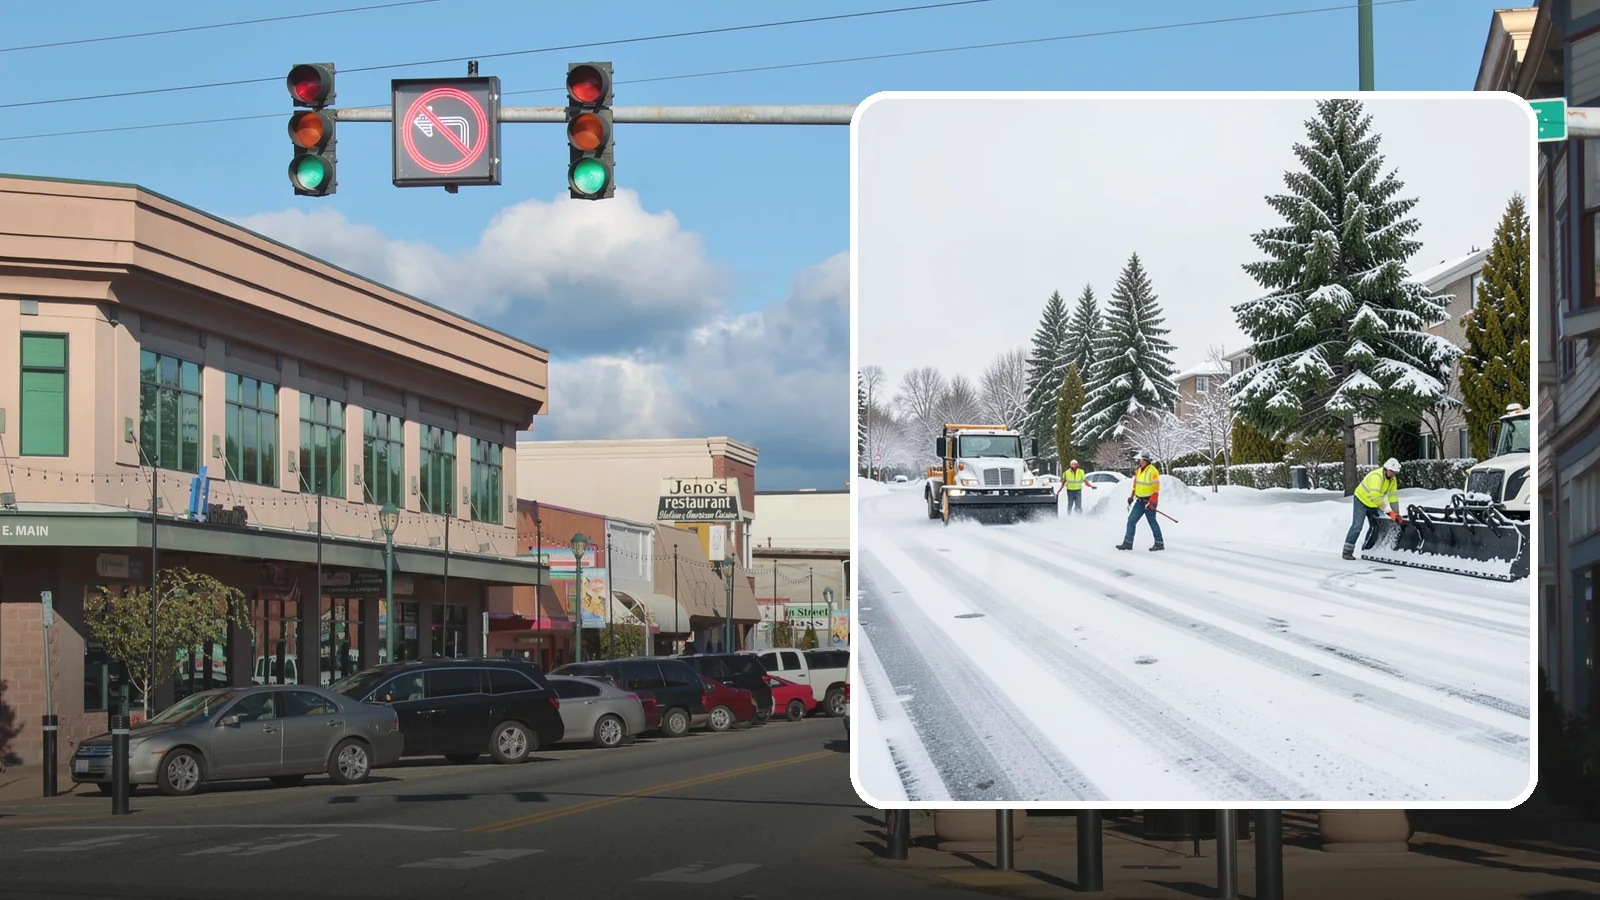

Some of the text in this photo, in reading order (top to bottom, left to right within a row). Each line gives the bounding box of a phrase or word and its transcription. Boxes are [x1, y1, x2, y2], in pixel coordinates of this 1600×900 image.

[670, 480, 727, 494] Jeno's
[665, 496, 731, 509] restaurant
[659, 510, 682, 519] Italian
[686, 509, 714, 519] American
[715, 510, 736, 519] Cuisine
[2, 525, 49, 536] E. MAIN
[797, 608, 828, 616] Street
